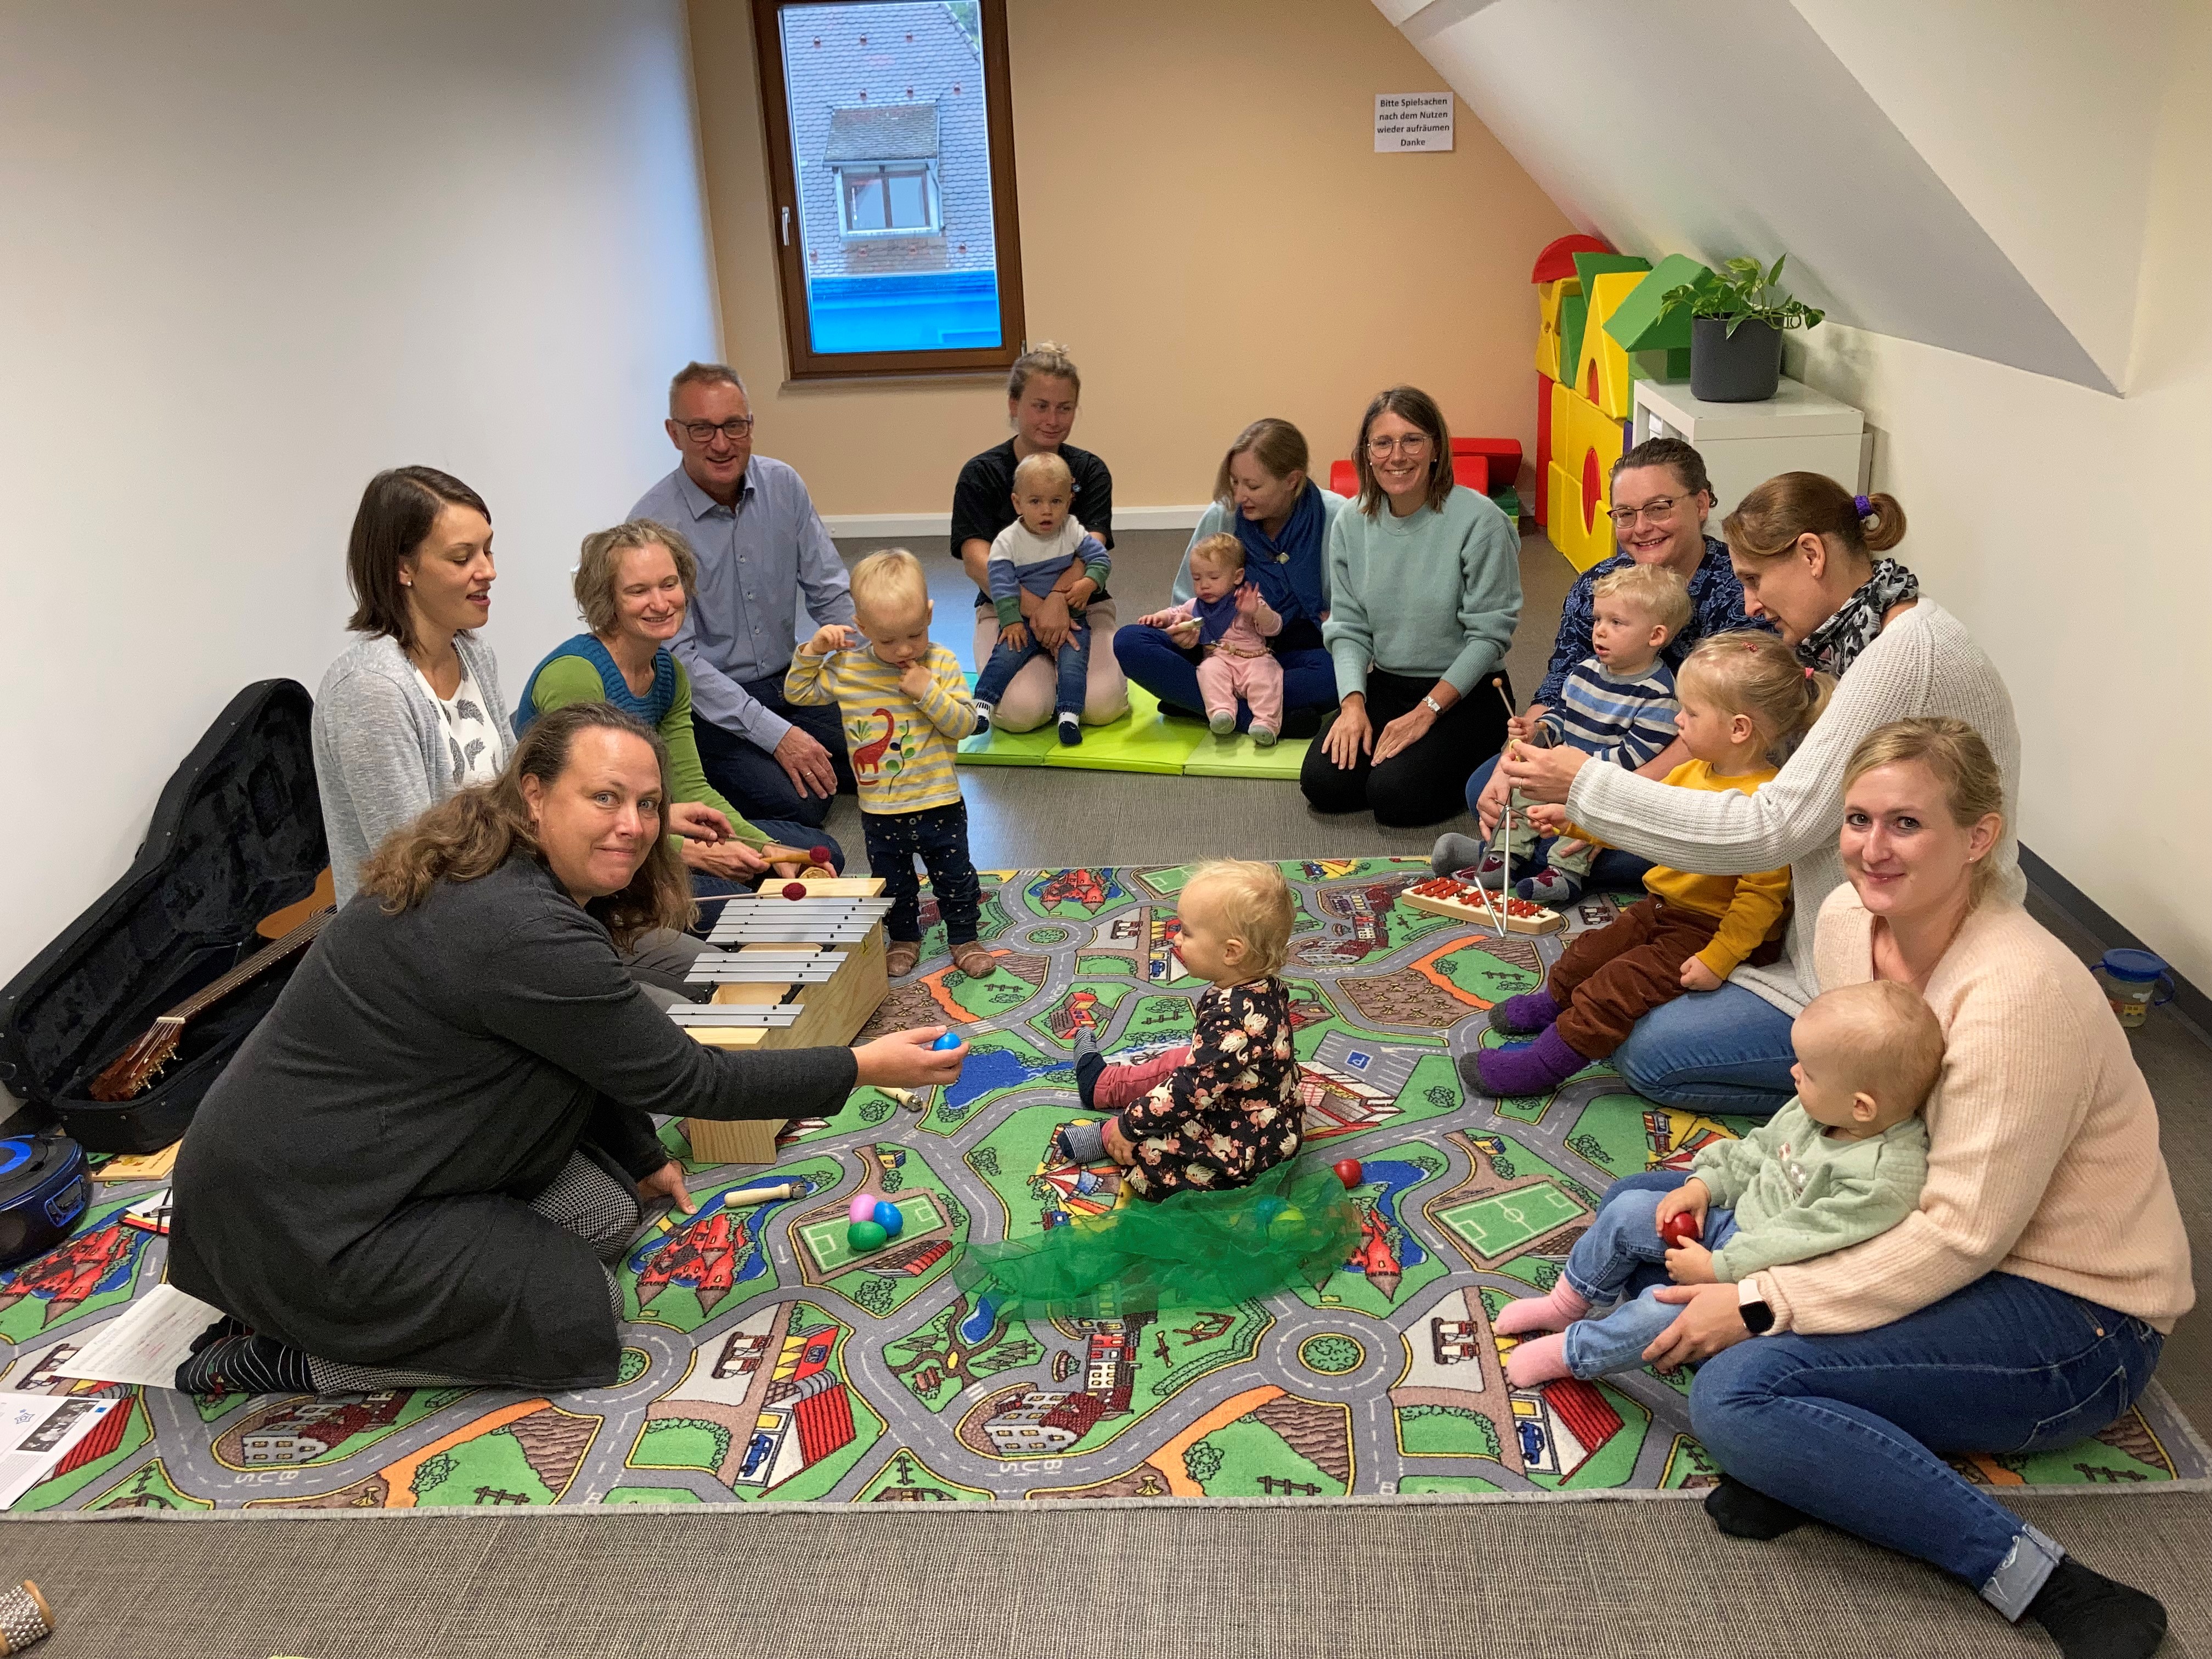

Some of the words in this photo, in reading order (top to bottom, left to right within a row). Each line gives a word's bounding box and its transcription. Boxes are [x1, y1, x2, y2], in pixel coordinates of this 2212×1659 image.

[1401, 98, 1447, 108] Spielsachen
[1000, 1459, 1062, 1472] BUS
[234, 1471, 299, 1483] BUS
